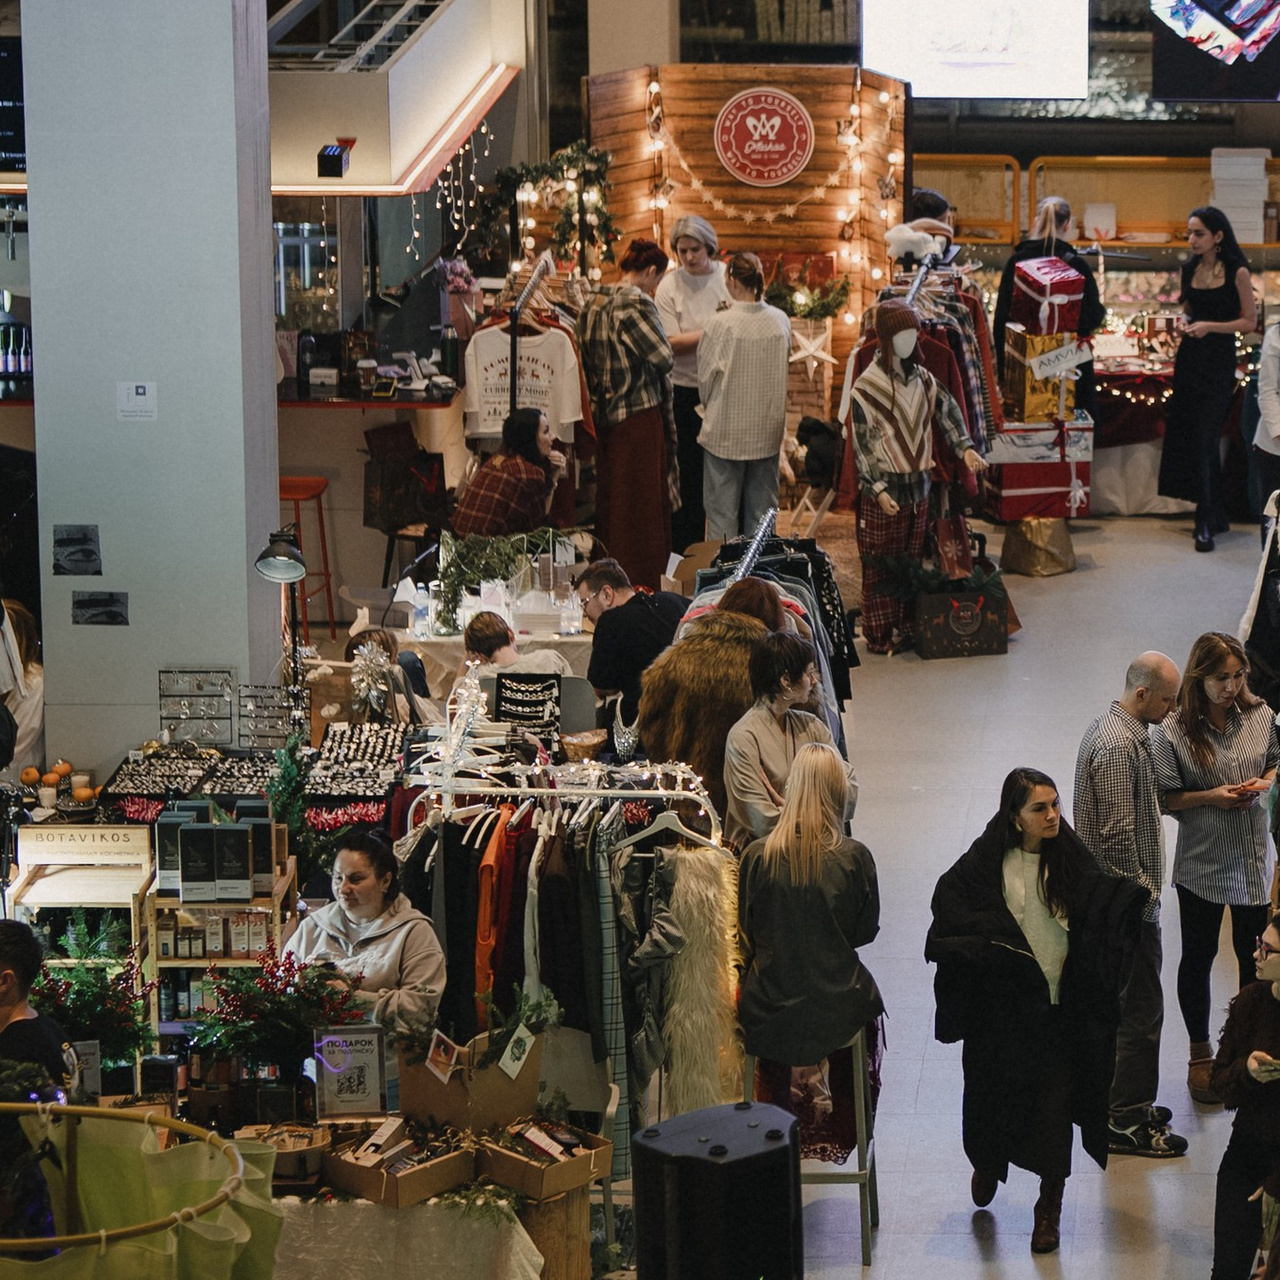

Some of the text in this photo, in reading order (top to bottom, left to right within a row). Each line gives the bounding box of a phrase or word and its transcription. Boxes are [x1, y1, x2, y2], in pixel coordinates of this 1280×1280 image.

[723, 95, 804, 127] WAY TO YOURSELF
[726, 149, 804, 179] WAY TO YOURSELF
[1037, 346, 1085, 370] AMVIA
[35, 833, 131, 843] BOTAVIKOS
[326, 1039, 374, 1048] ПОДАРОК
[338, 1047, 375, 1056] подписку
